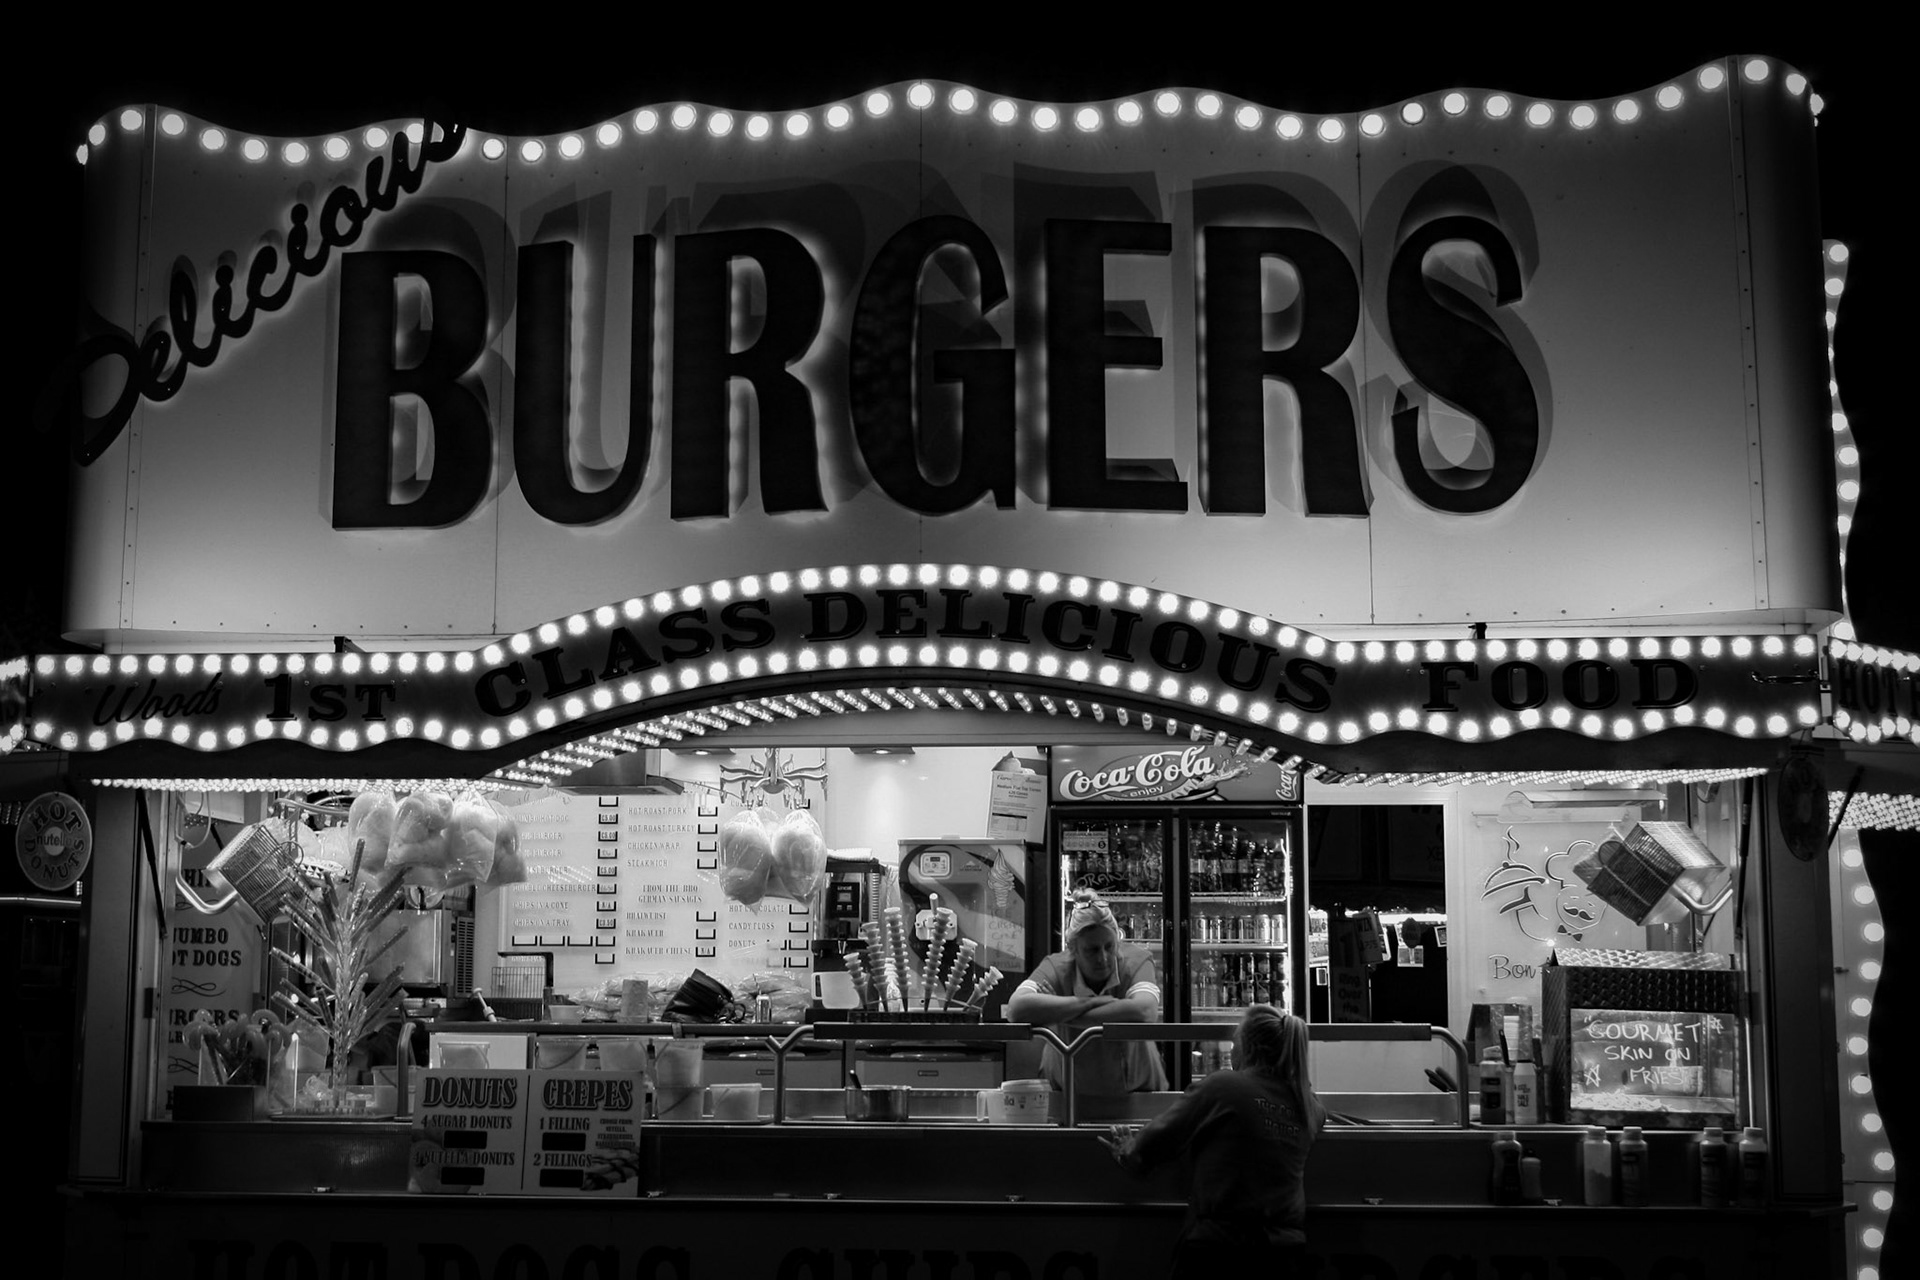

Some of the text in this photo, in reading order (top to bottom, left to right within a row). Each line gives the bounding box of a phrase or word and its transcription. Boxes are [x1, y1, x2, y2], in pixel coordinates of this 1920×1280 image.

[32, 98, 468, 468] Delicious
[333, 214, 1540, 530] BURGERS
[264, 588, 1699, 721] 1ST CLASS DELICIOUS FOOD
[1837, 657, 1900, 717] HOT
[1059, 744, 1216, 801] Coca-Cola
[1129, 784, 1164, 798] enjoy
[28, 800, 82, 833] HOT
[24, 839, 86, 880] DONUTS
[192, 949, 242, 967] DOGS
[1488, 954, 1537, 980] Bon
[1604, 1045, 1691, 1061] SKIN ON
[1629, 1066, 1684, 1086] FRIES
[422, 1076, 518, 1109] DONUTS
[542, 1078, 633, 1111] CREPES
[421, 1115, 513, 1130] 4 SUGAR DONUTS
[540, 1117, 590, 1131] 1 FILLING
[472, 1152, 516, 1167] DONUTS
[533, 1153, 593, 1168] 2 FILLINGS
